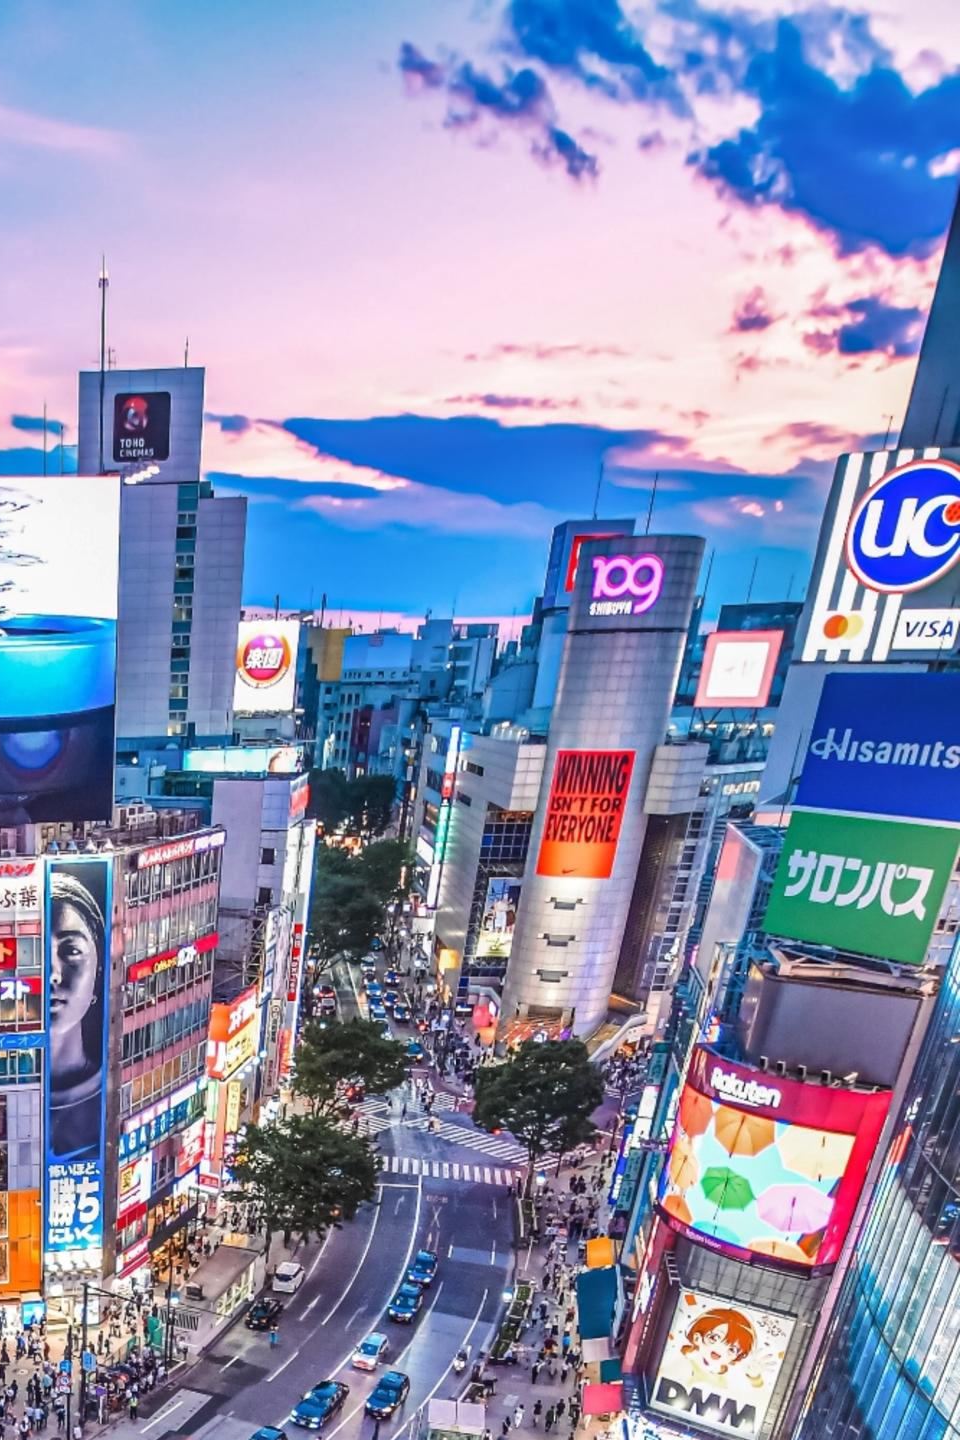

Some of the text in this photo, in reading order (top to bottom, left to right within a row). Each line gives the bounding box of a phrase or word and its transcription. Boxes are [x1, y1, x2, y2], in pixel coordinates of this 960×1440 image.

[120, 438, 145, 449] TOHO
[120, 447, 154, 458] CINEMAS
[592, 553, 665, 614] 109
[589, 600, 633, 616] SHIBUYA
[905, 620, 954, 638] VISA
[555, 754, 629, 795] WINNING
[550, 796, 622, 813] ISN'T FOR
[545, 814, 617, 843] EVERYONE.
[784, 848, 935, 922] サロンパス
[711, 1066, 782, 1109] Rakuten
[48, 1176, 100, 1228] 勝ち
[48, 1224, 101, 1244] にいく
[655, 1377, 757, 1434] DMM
